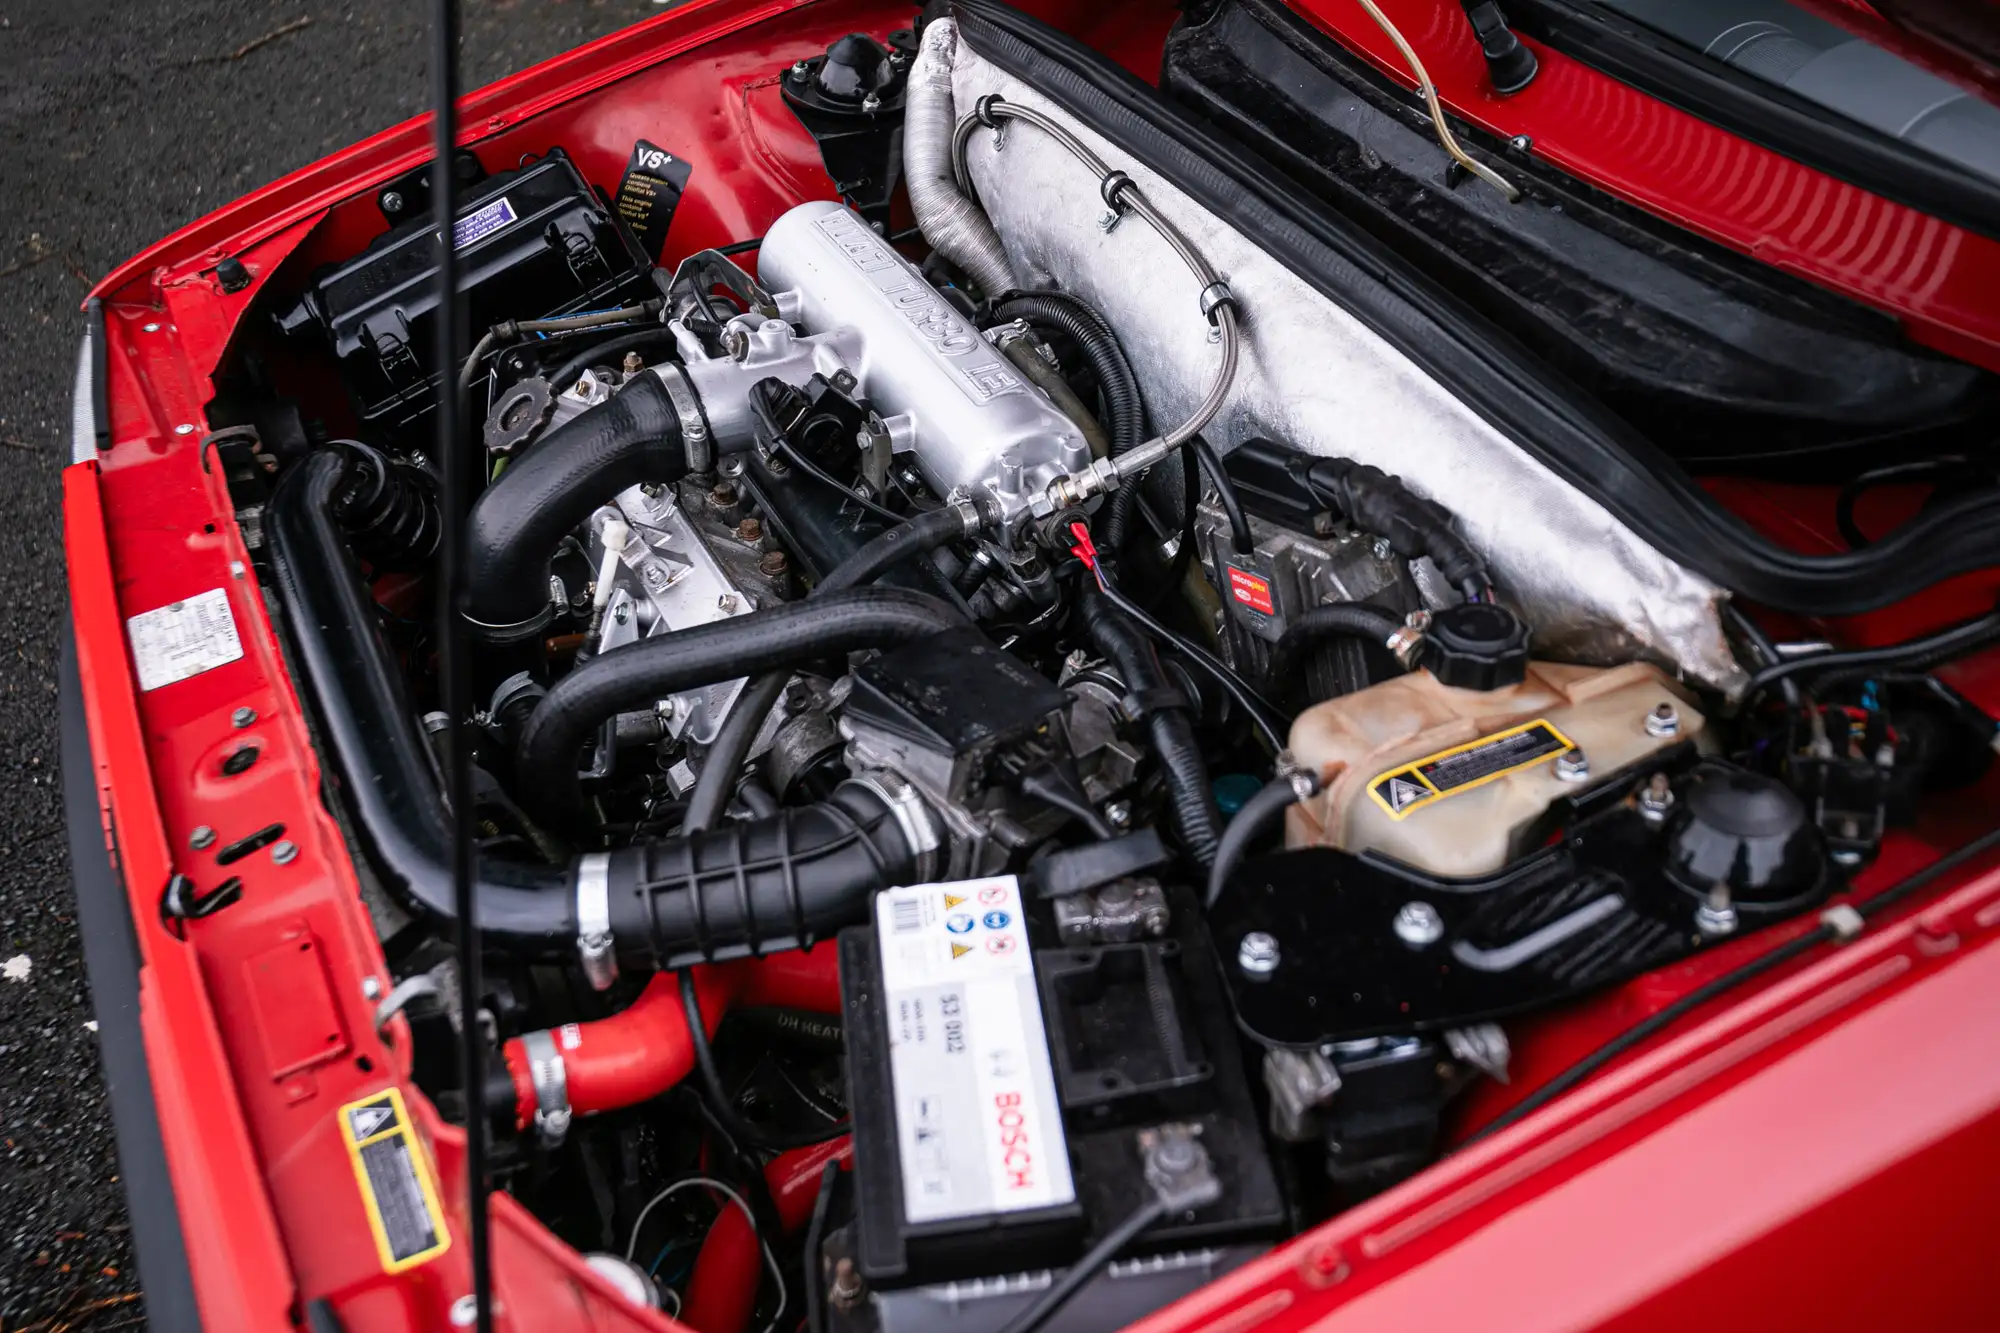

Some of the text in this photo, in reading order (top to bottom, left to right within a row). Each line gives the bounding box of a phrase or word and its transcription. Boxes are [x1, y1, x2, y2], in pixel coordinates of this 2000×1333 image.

[638, 148, 672, 169] VS+
[621, 194, 653, 207] This engine
[475, 214, 501, 229] CLEANER
[819, 212, 897, 273] FIAT
[880, 276, 979, 356] TURBO
[995, 1091, 1034, 1190] BOSCH
